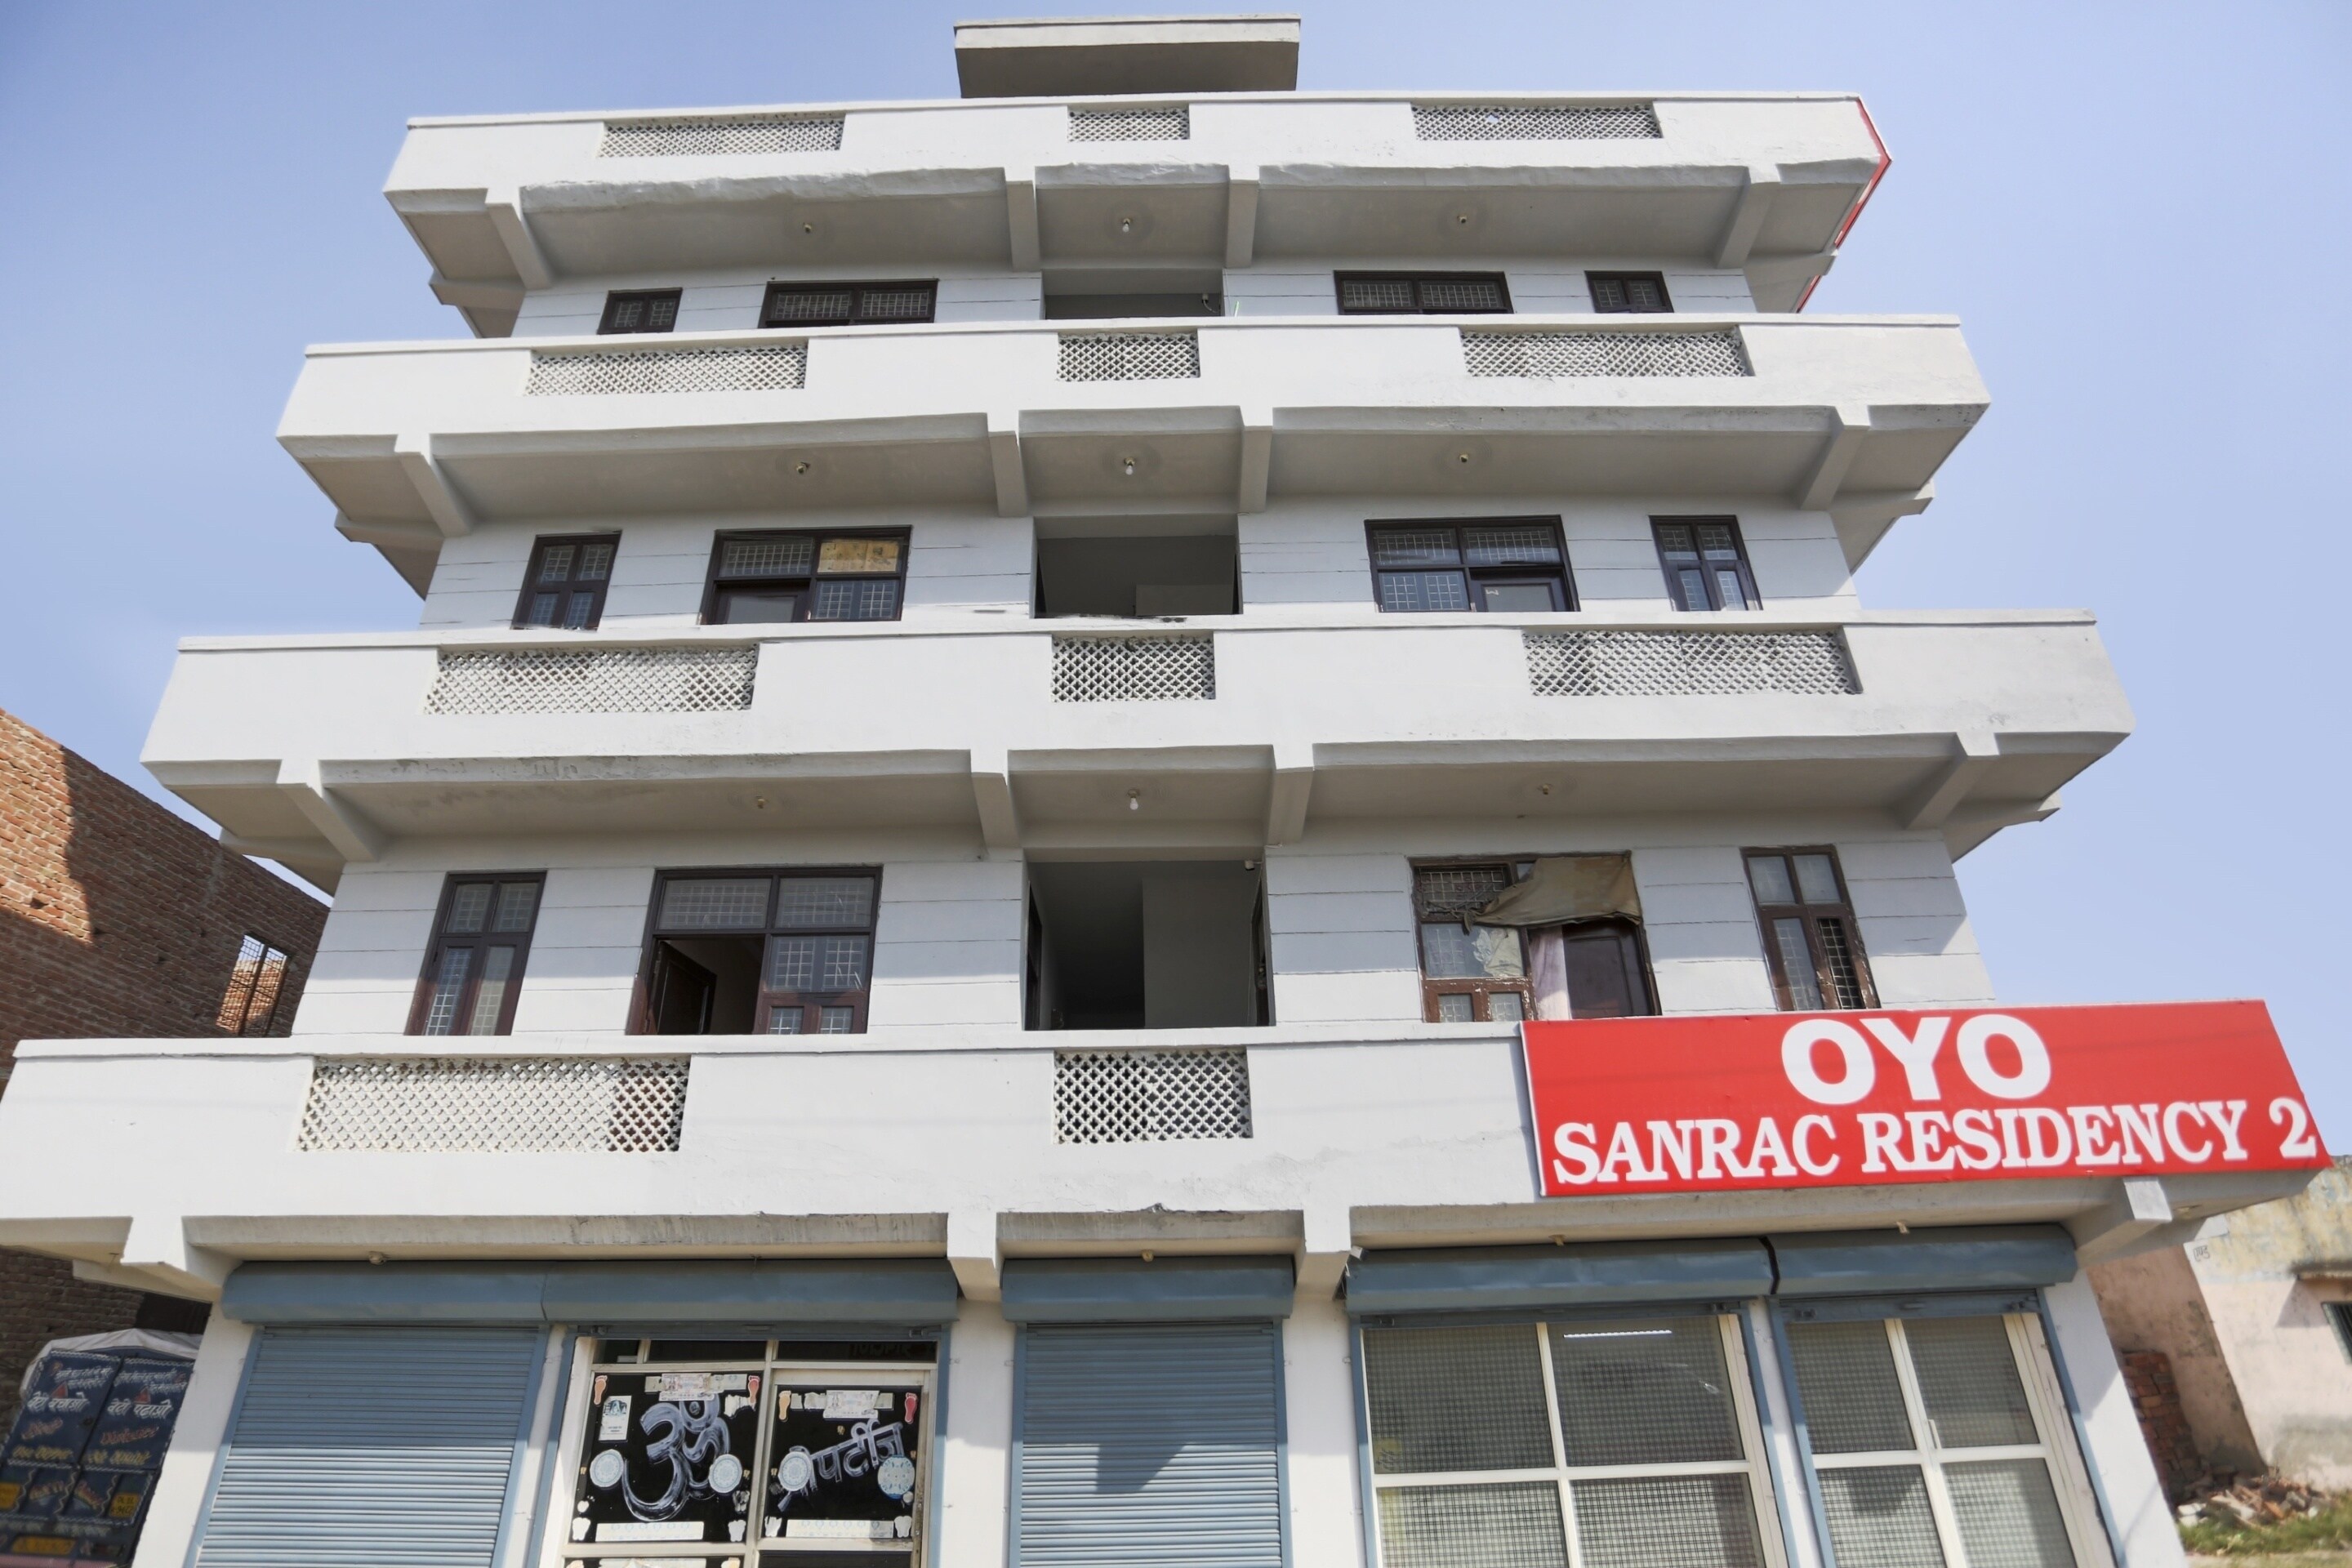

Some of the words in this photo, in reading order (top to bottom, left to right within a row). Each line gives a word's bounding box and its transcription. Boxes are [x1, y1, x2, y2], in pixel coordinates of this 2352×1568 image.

[1781, 1013, 2051, 1105] OYO
[1552, 1114, 1840, 1185] SANRAC
[1856, 1099, 2248, 1173] RESIDENCY
[2269, 1097, 2318, 1158] 2
